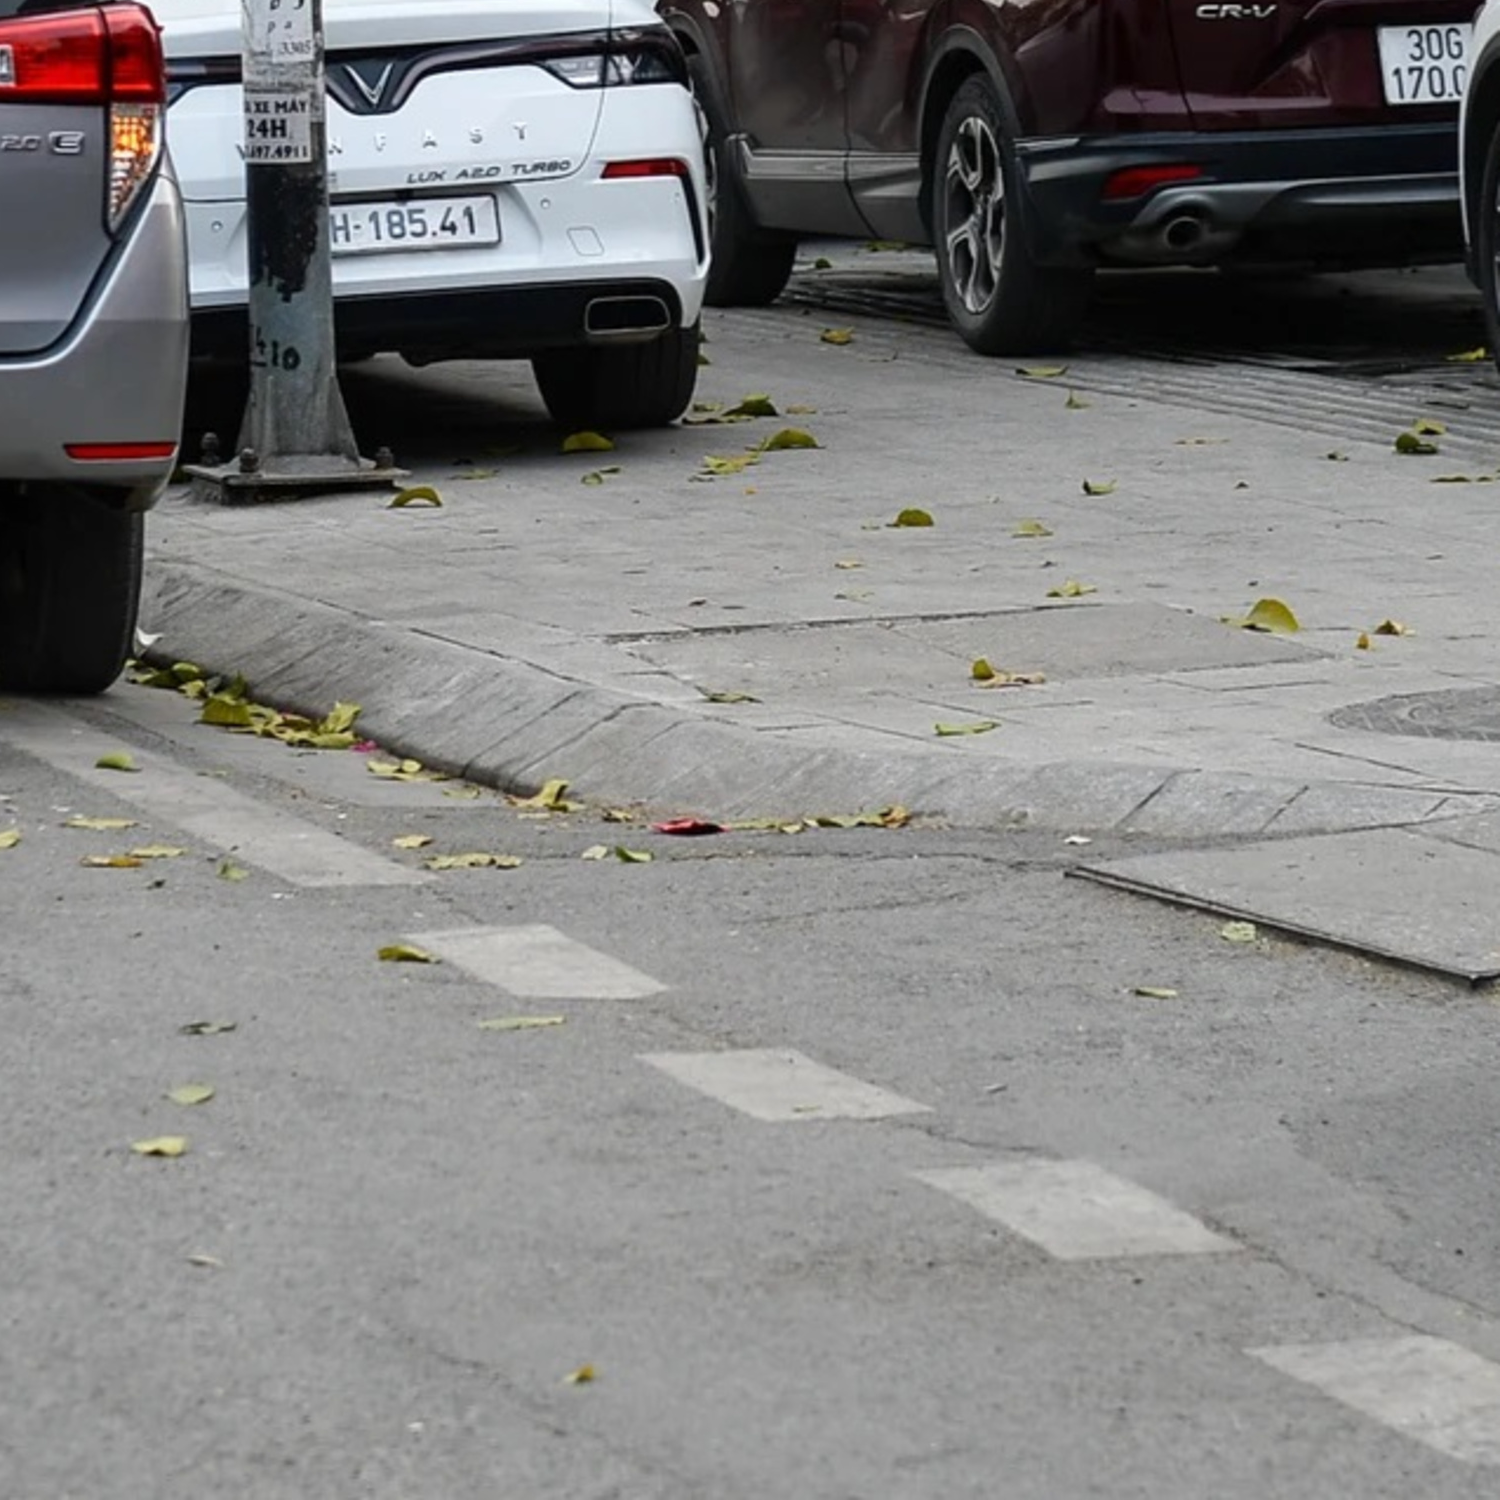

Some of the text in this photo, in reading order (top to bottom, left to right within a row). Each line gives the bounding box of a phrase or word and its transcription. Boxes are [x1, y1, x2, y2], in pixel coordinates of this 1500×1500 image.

[1195, 3, 1278, 19] CR-V
[1406, 26, 1464, 62] 30G
[247, 118, 287, 138] 24H
[405, 171, 447, 185] LUX
[511, 159, 572, 176] TURBO
